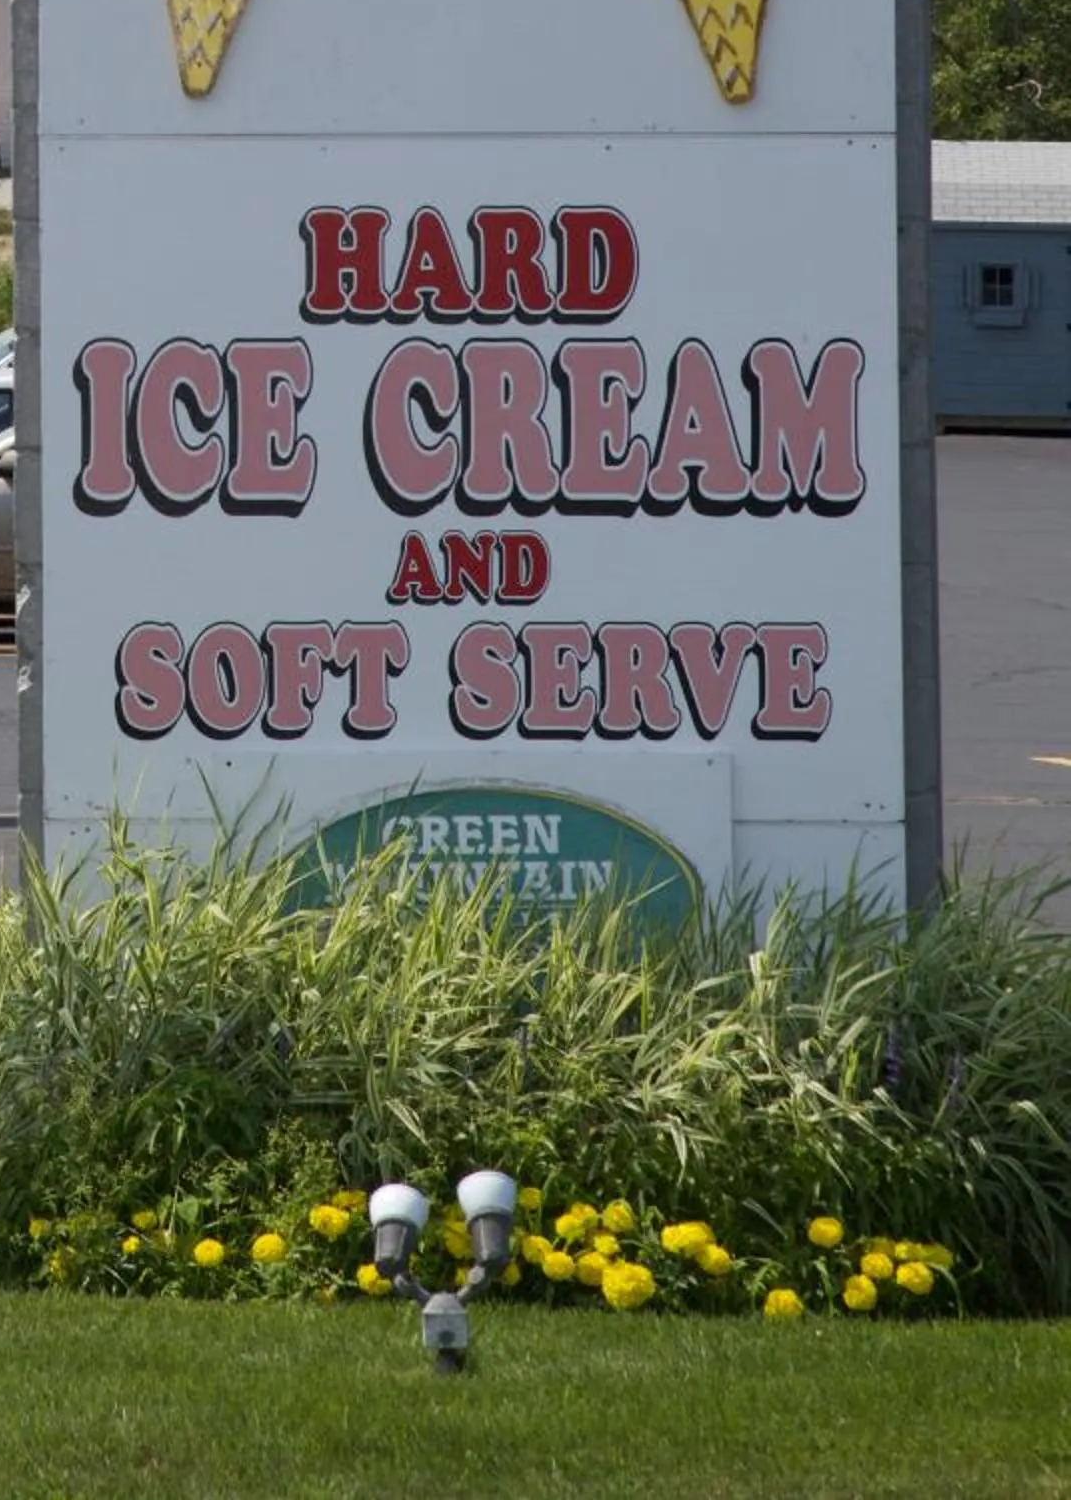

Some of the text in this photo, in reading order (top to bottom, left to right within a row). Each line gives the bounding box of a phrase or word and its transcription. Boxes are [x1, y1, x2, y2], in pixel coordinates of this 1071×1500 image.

[299, 206, 638, 325] HARD
[73, 337, 866, 518] ICE CREAM
[385, 530, 551, 605] AND
[114, 620, 833, 741] SOFT SERVE
[382, 814, 562, 855] GREEN
